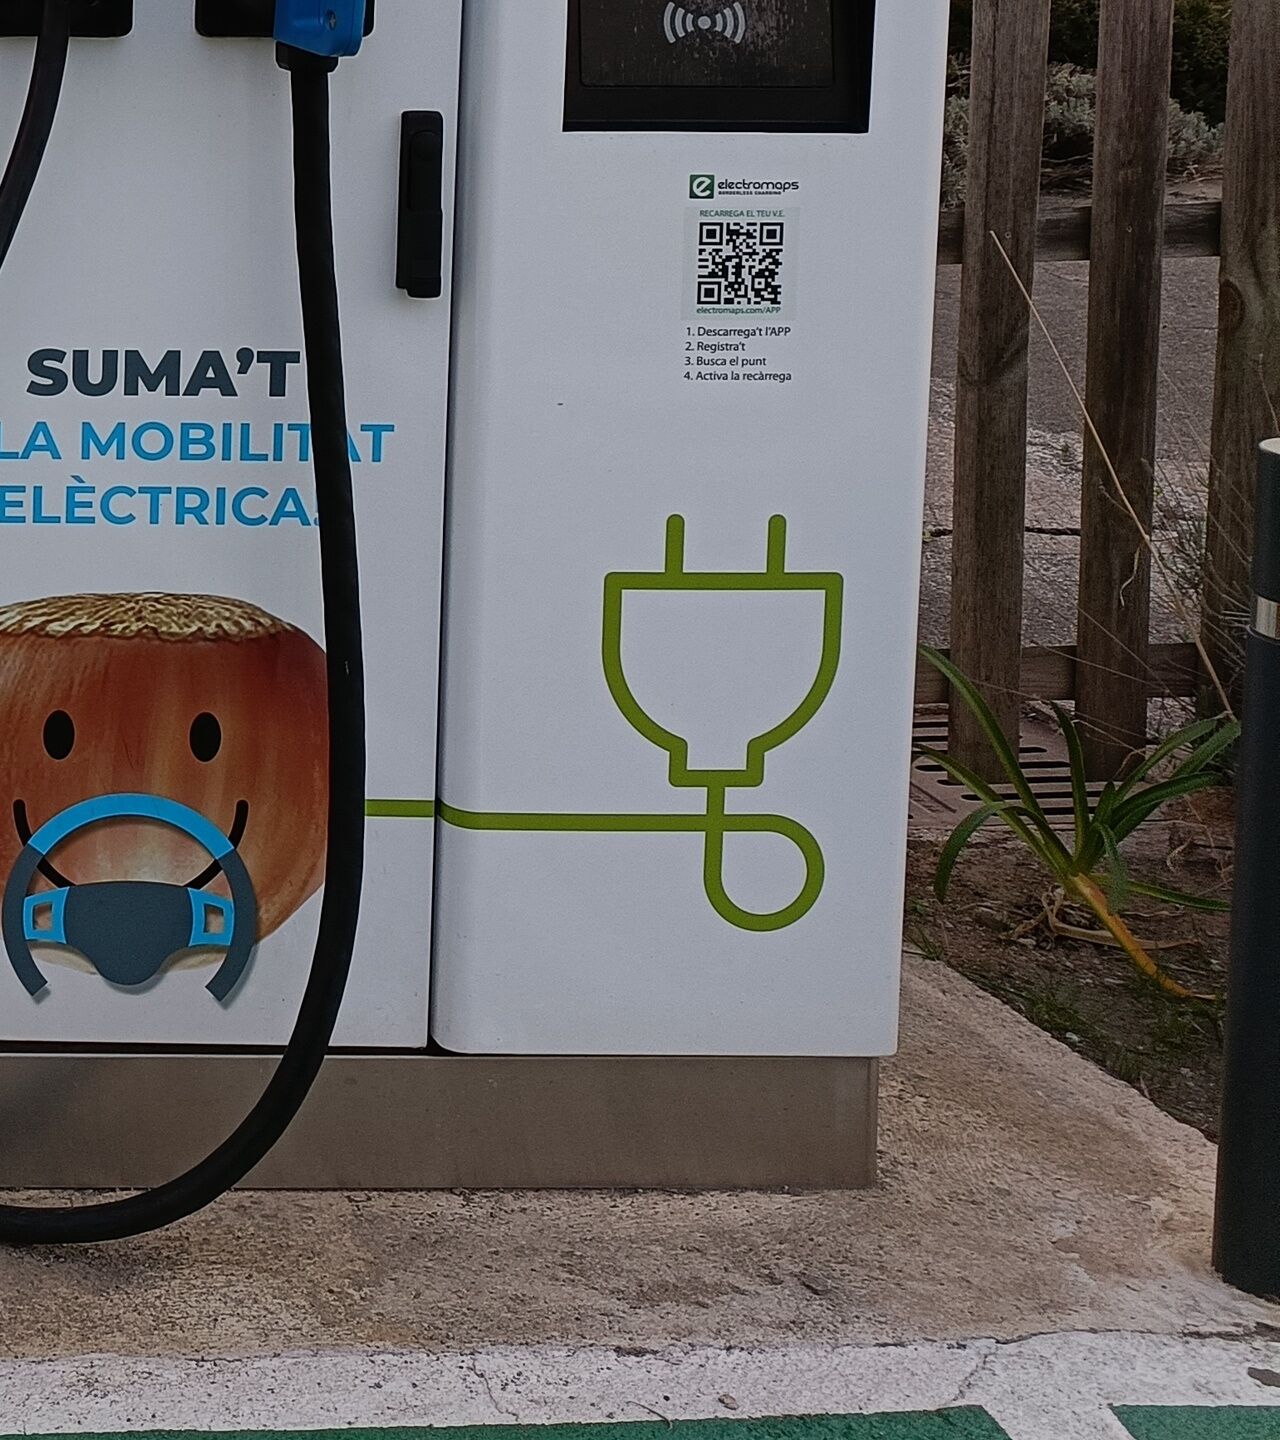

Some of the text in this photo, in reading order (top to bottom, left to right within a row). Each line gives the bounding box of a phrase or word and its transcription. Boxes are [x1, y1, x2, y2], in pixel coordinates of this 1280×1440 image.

[717, 178, 800, 192] electromaps
[696, 306, 781, 315] electromaps.com/APP
[686, 327, 695, 336] 1.
[697, 326, 763, 339] Descarrega't
[685, 342, 746, 353] 2. Registra't
[685, 356, 767, 368] 3. Busca el punt
[25, 346, 301, 398] SUMA'T
[683, 371, 792, 383] 4. Activa la recàrrega
[81, 421, 395, 463] MOBILITT
